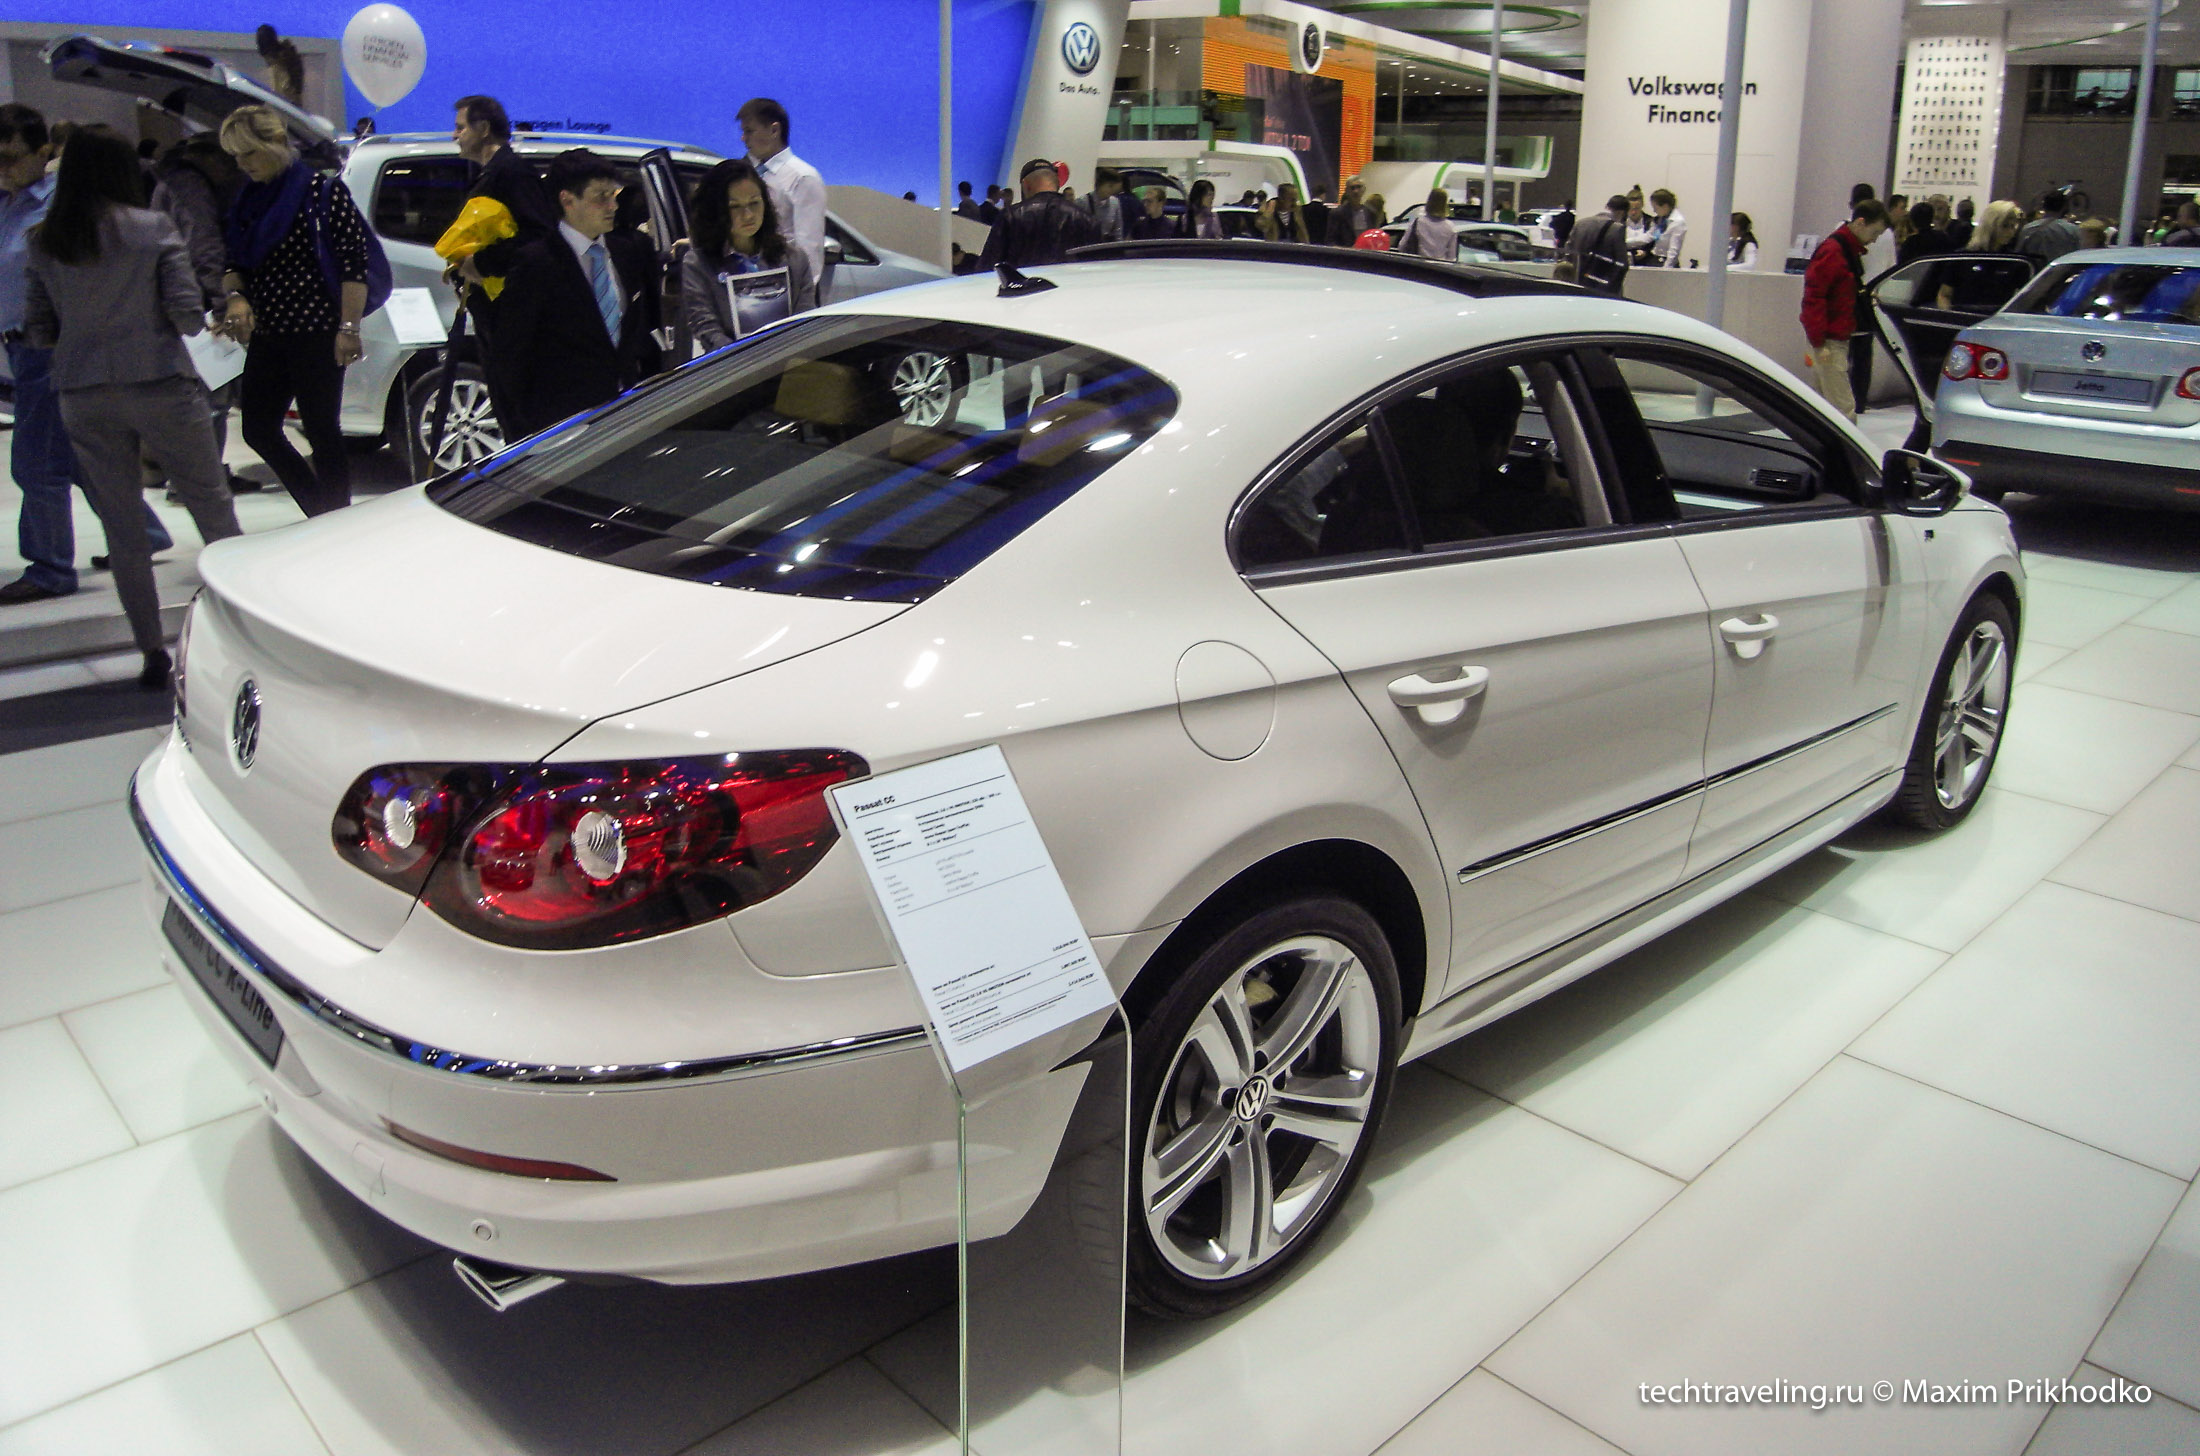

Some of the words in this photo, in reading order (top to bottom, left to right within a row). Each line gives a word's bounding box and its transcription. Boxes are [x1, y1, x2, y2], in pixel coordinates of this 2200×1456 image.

[1060, 82, 1075, 93] Das
[567, 117, 611, 133] Lounge
[854, 800, 883, 812] Passat
[883, 795, 895, 804] CC
